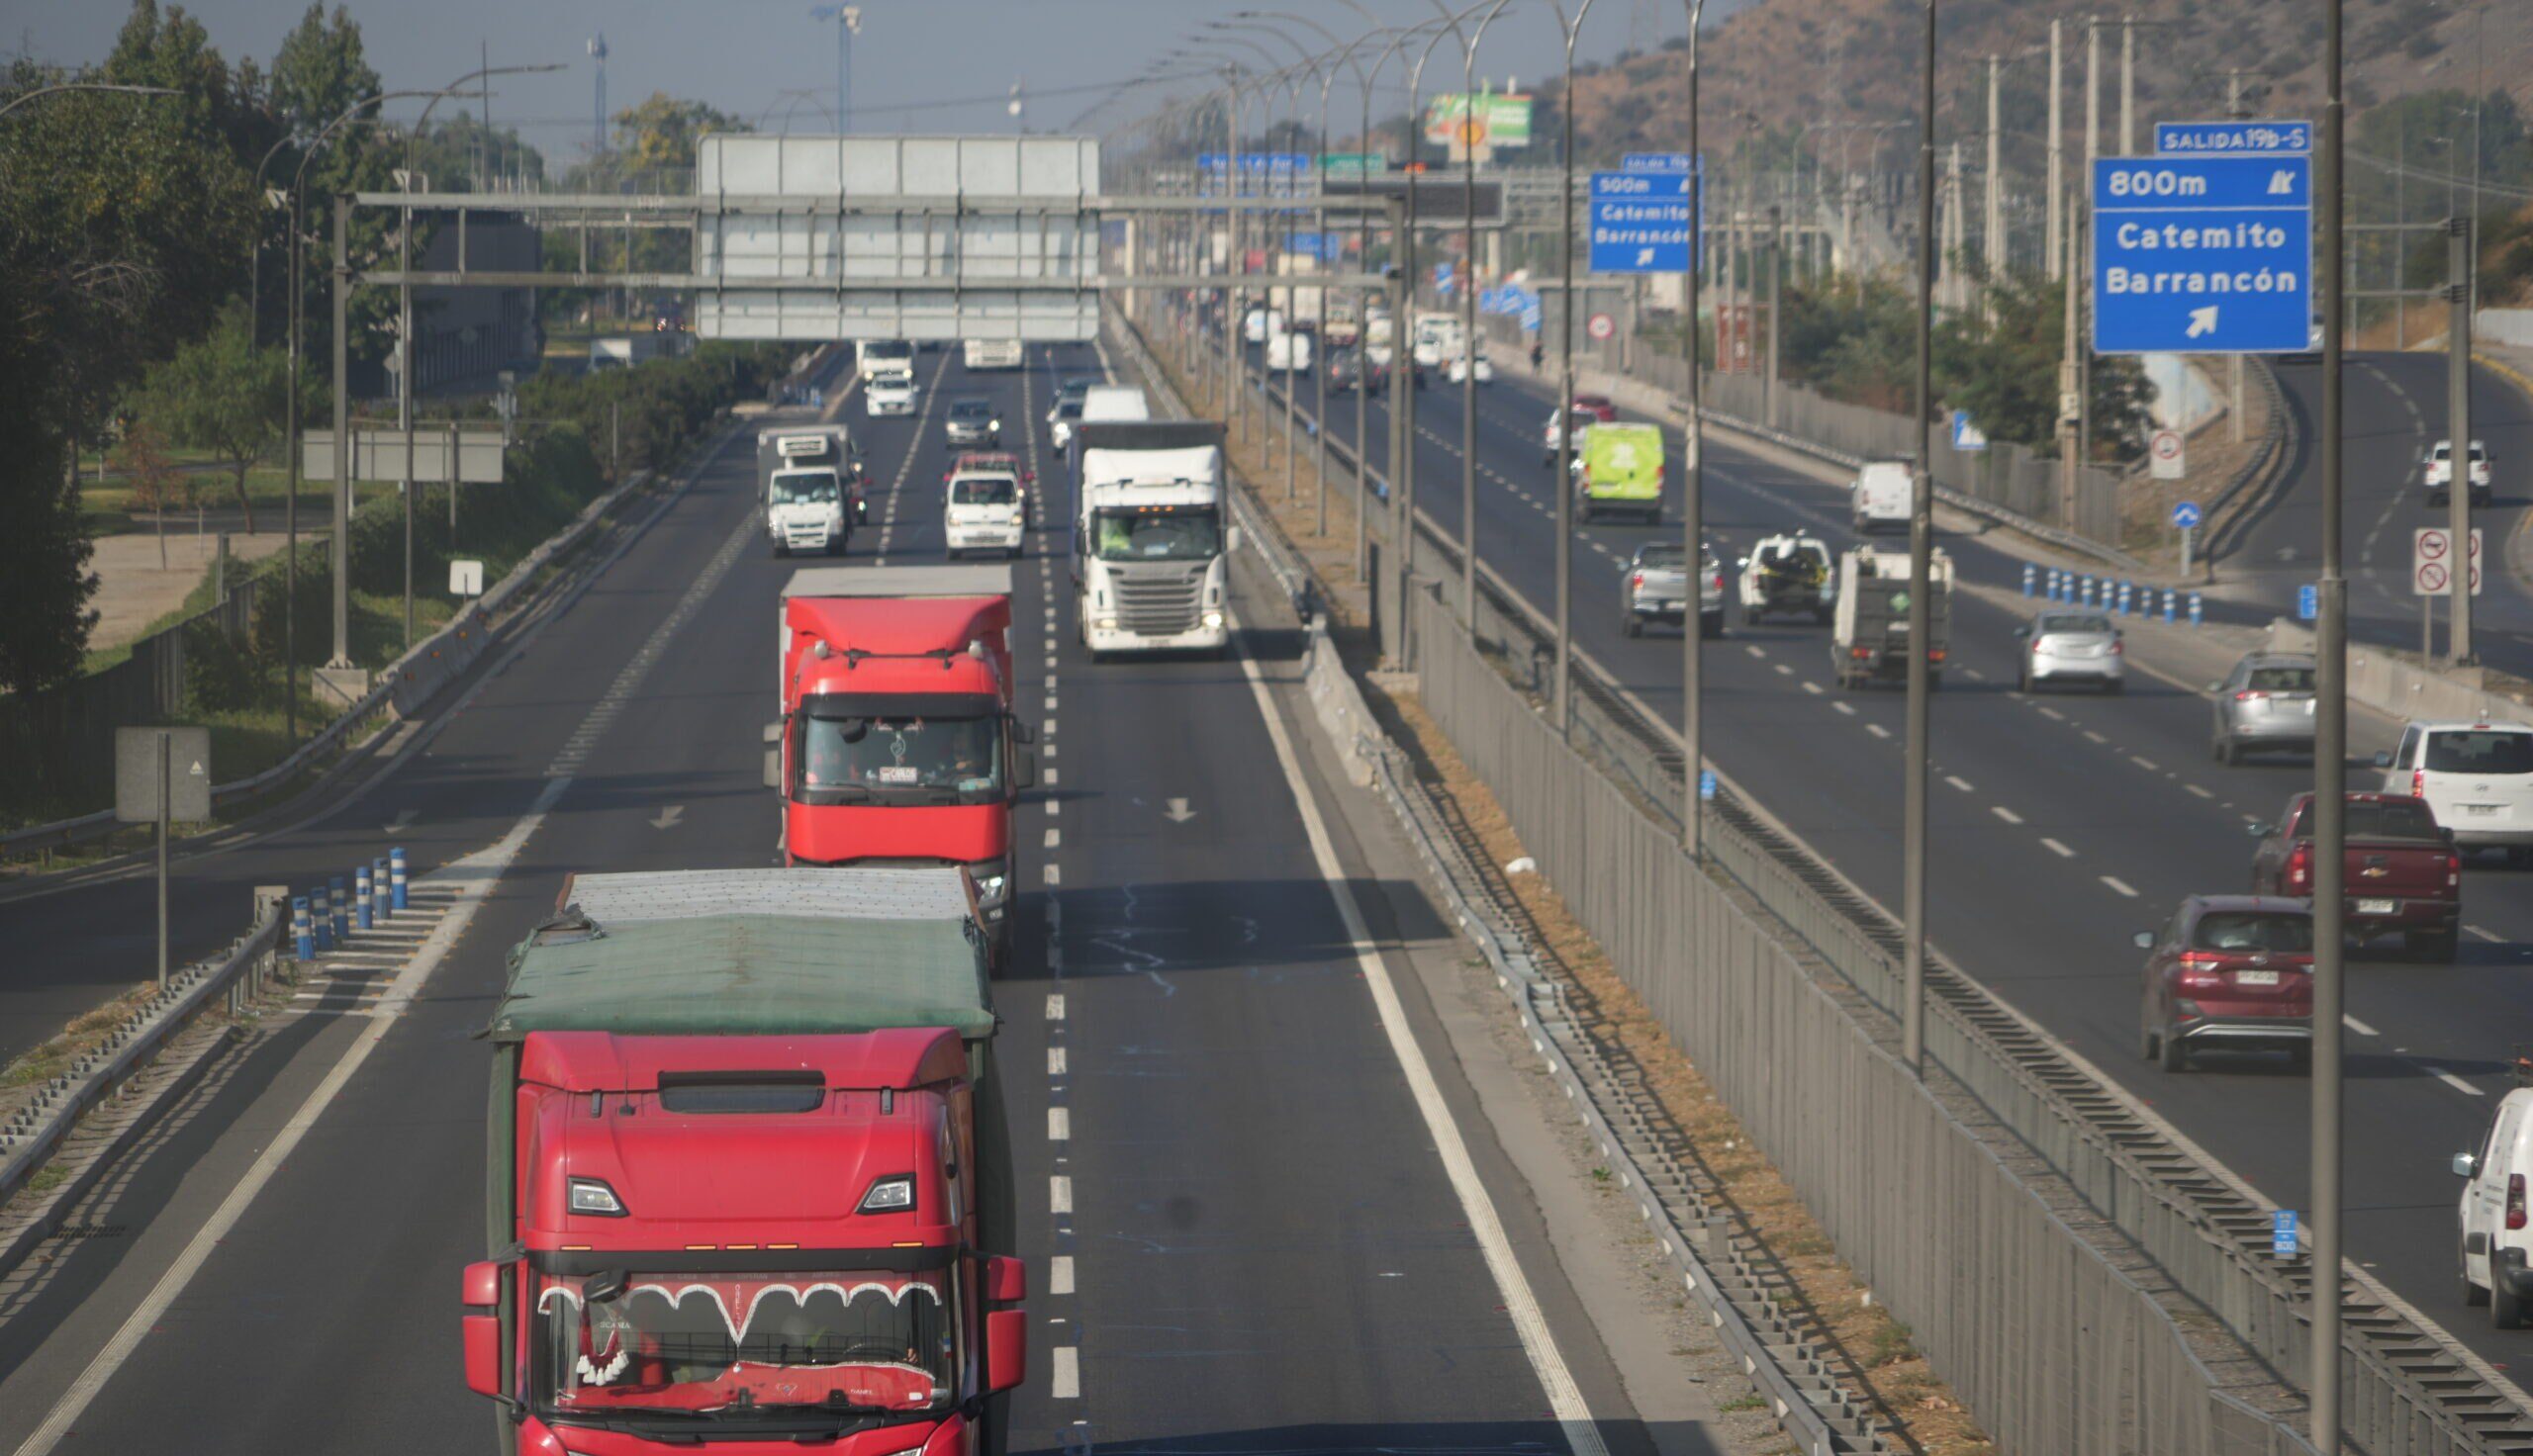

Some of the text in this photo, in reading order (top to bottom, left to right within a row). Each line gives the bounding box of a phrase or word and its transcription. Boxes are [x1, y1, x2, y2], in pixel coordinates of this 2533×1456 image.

[2164, 132, 2245, 149] SALIDA
[1599, 177, 1650, 194] 500m
[2109, 170, 2207, 196] 800m
[1601, 204, 1690, 222] Catemito
[2116, 222, 2287, 249] Catemito
[2106, 266, 2298, 294] Barrancón
